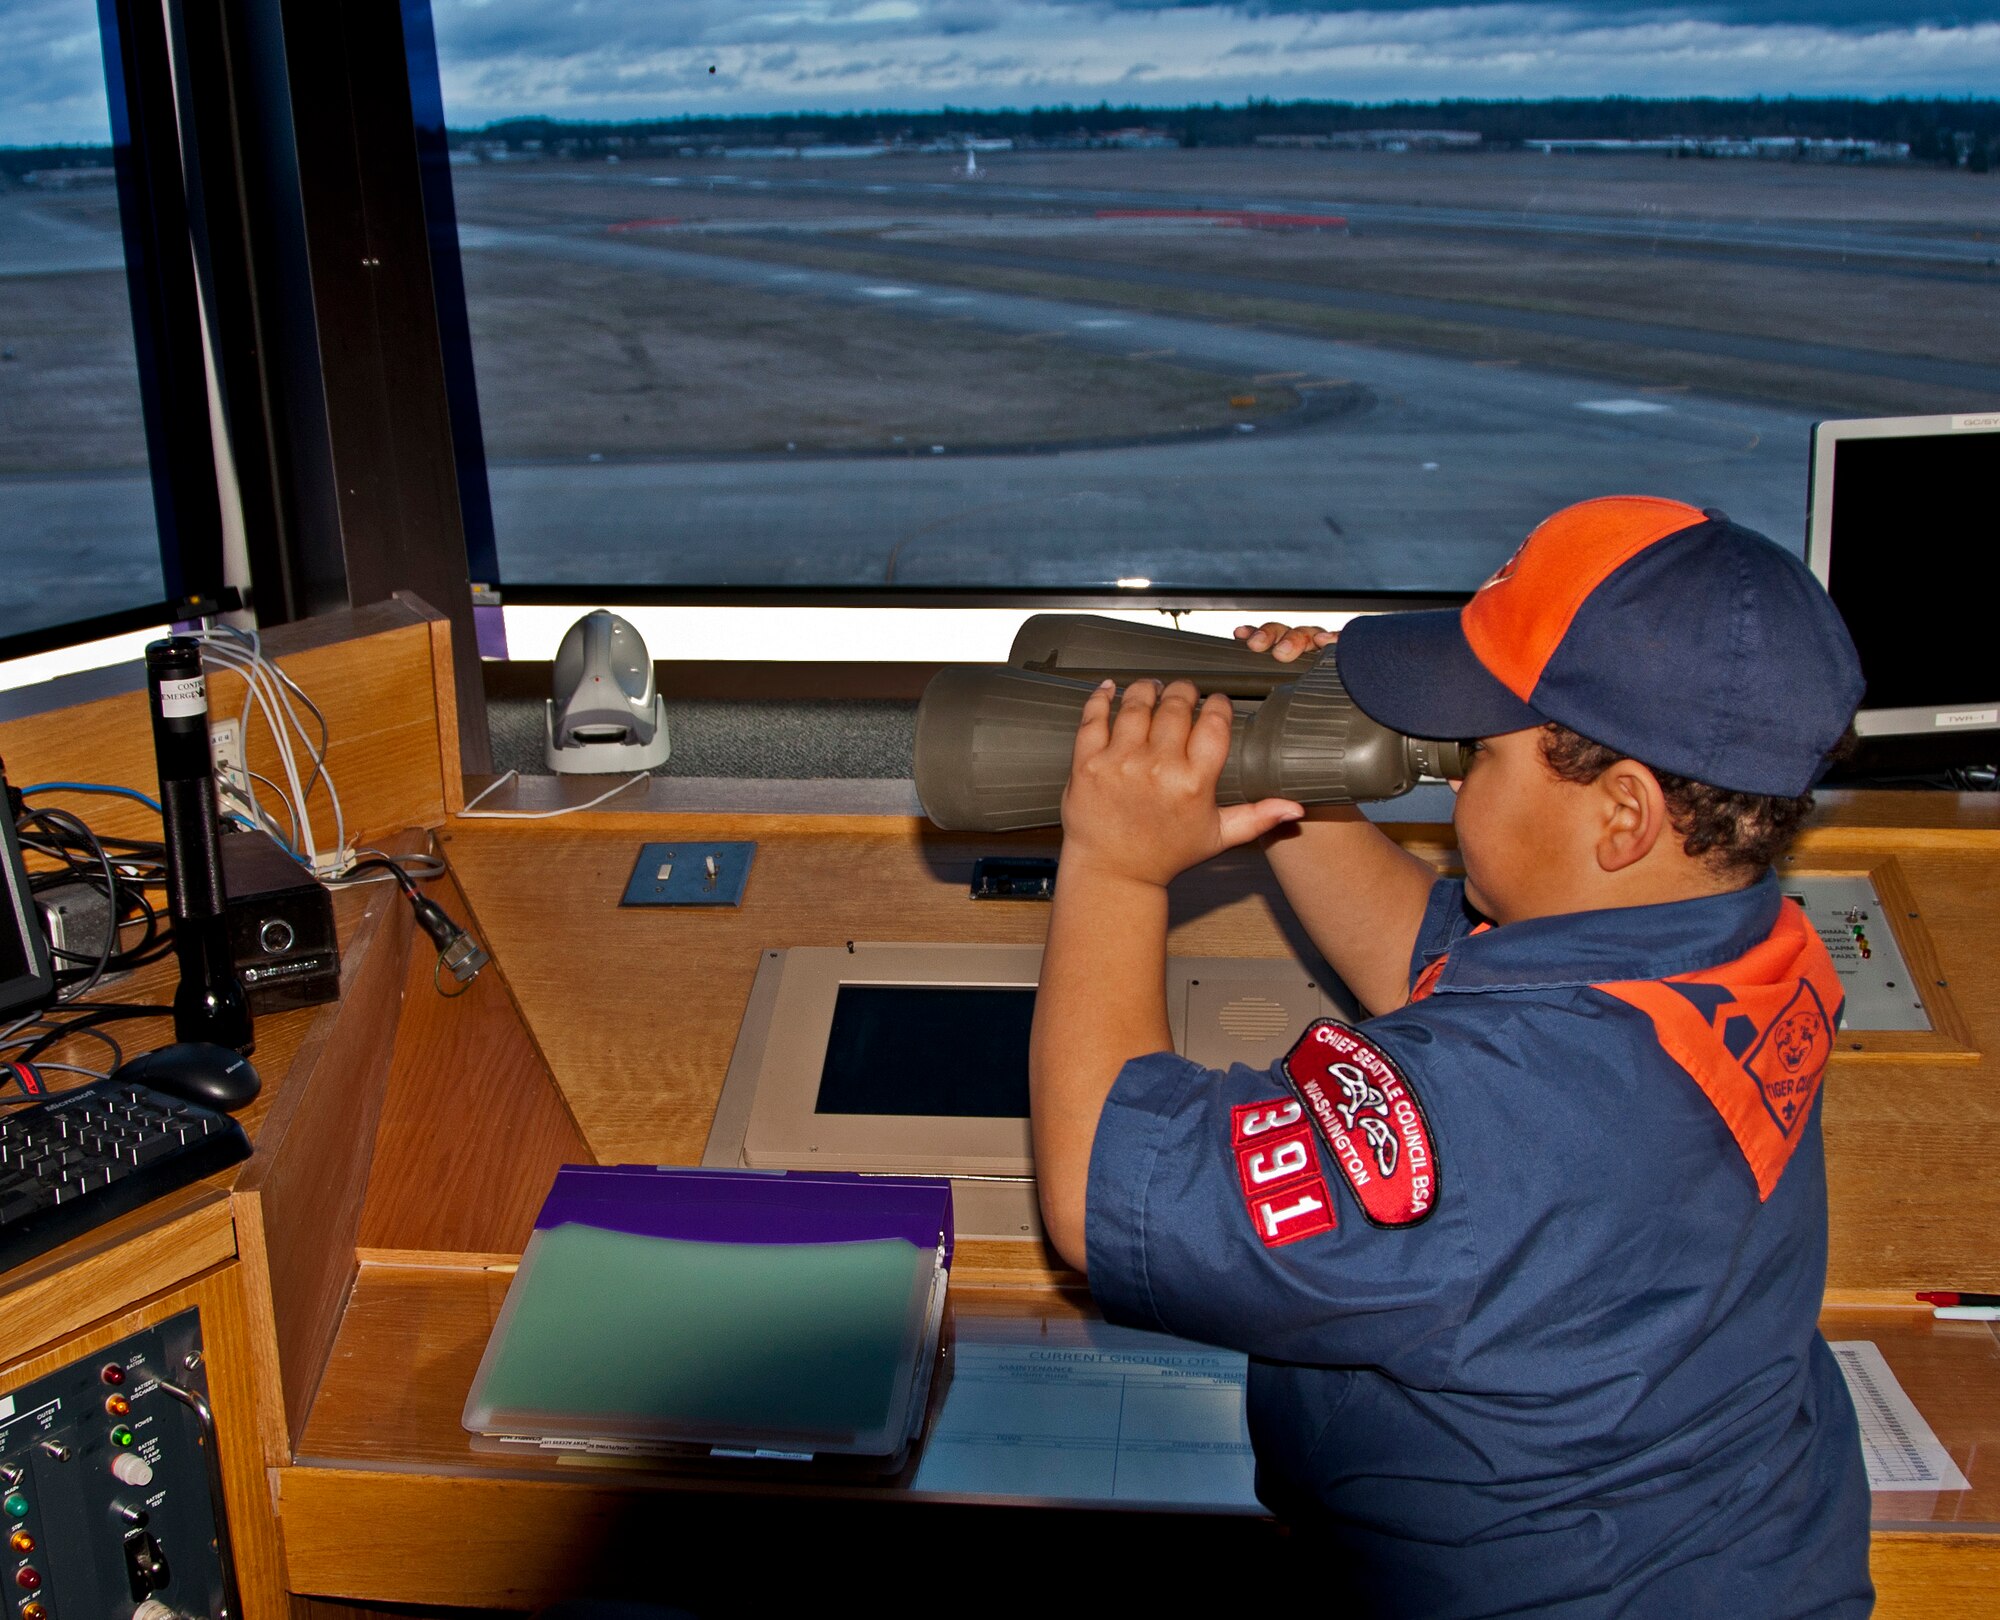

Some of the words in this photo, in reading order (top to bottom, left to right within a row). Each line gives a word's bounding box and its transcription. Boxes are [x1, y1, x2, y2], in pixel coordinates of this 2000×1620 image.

[1766, 1078, 1795, 1099] TIGER
[43, 1088, 96, 1112] Microsoft
[1316, 1026, 1356, 1053] CHIEF
[1352, 1047, 1403, 1101] SEATTLE
[1393, 1102, 1429, 1172] COUNCIL
[1411, 1175, 1430, 1214] BSA
[1302, 1079, 1371, 1186] WASHINGTON
[126, 1357, 146, 1370] BATTERY
[1029, 1350, 1106, 1362] CURRENT
[1109, 1353, 1182, 1365] GROUND
[1185, 1356, 1220, 1367] OPS
[134, 1379, 154, 1392] BATTERY
[36, 1408, 55, 1420] OUTER
[134, 1416, 153, 1429] POWER
[138, 1436, 159, 1451] BATTERY
[145, 1490, 167, 1505] BATTERY
[151, 1498, 164, 1508] TEST
